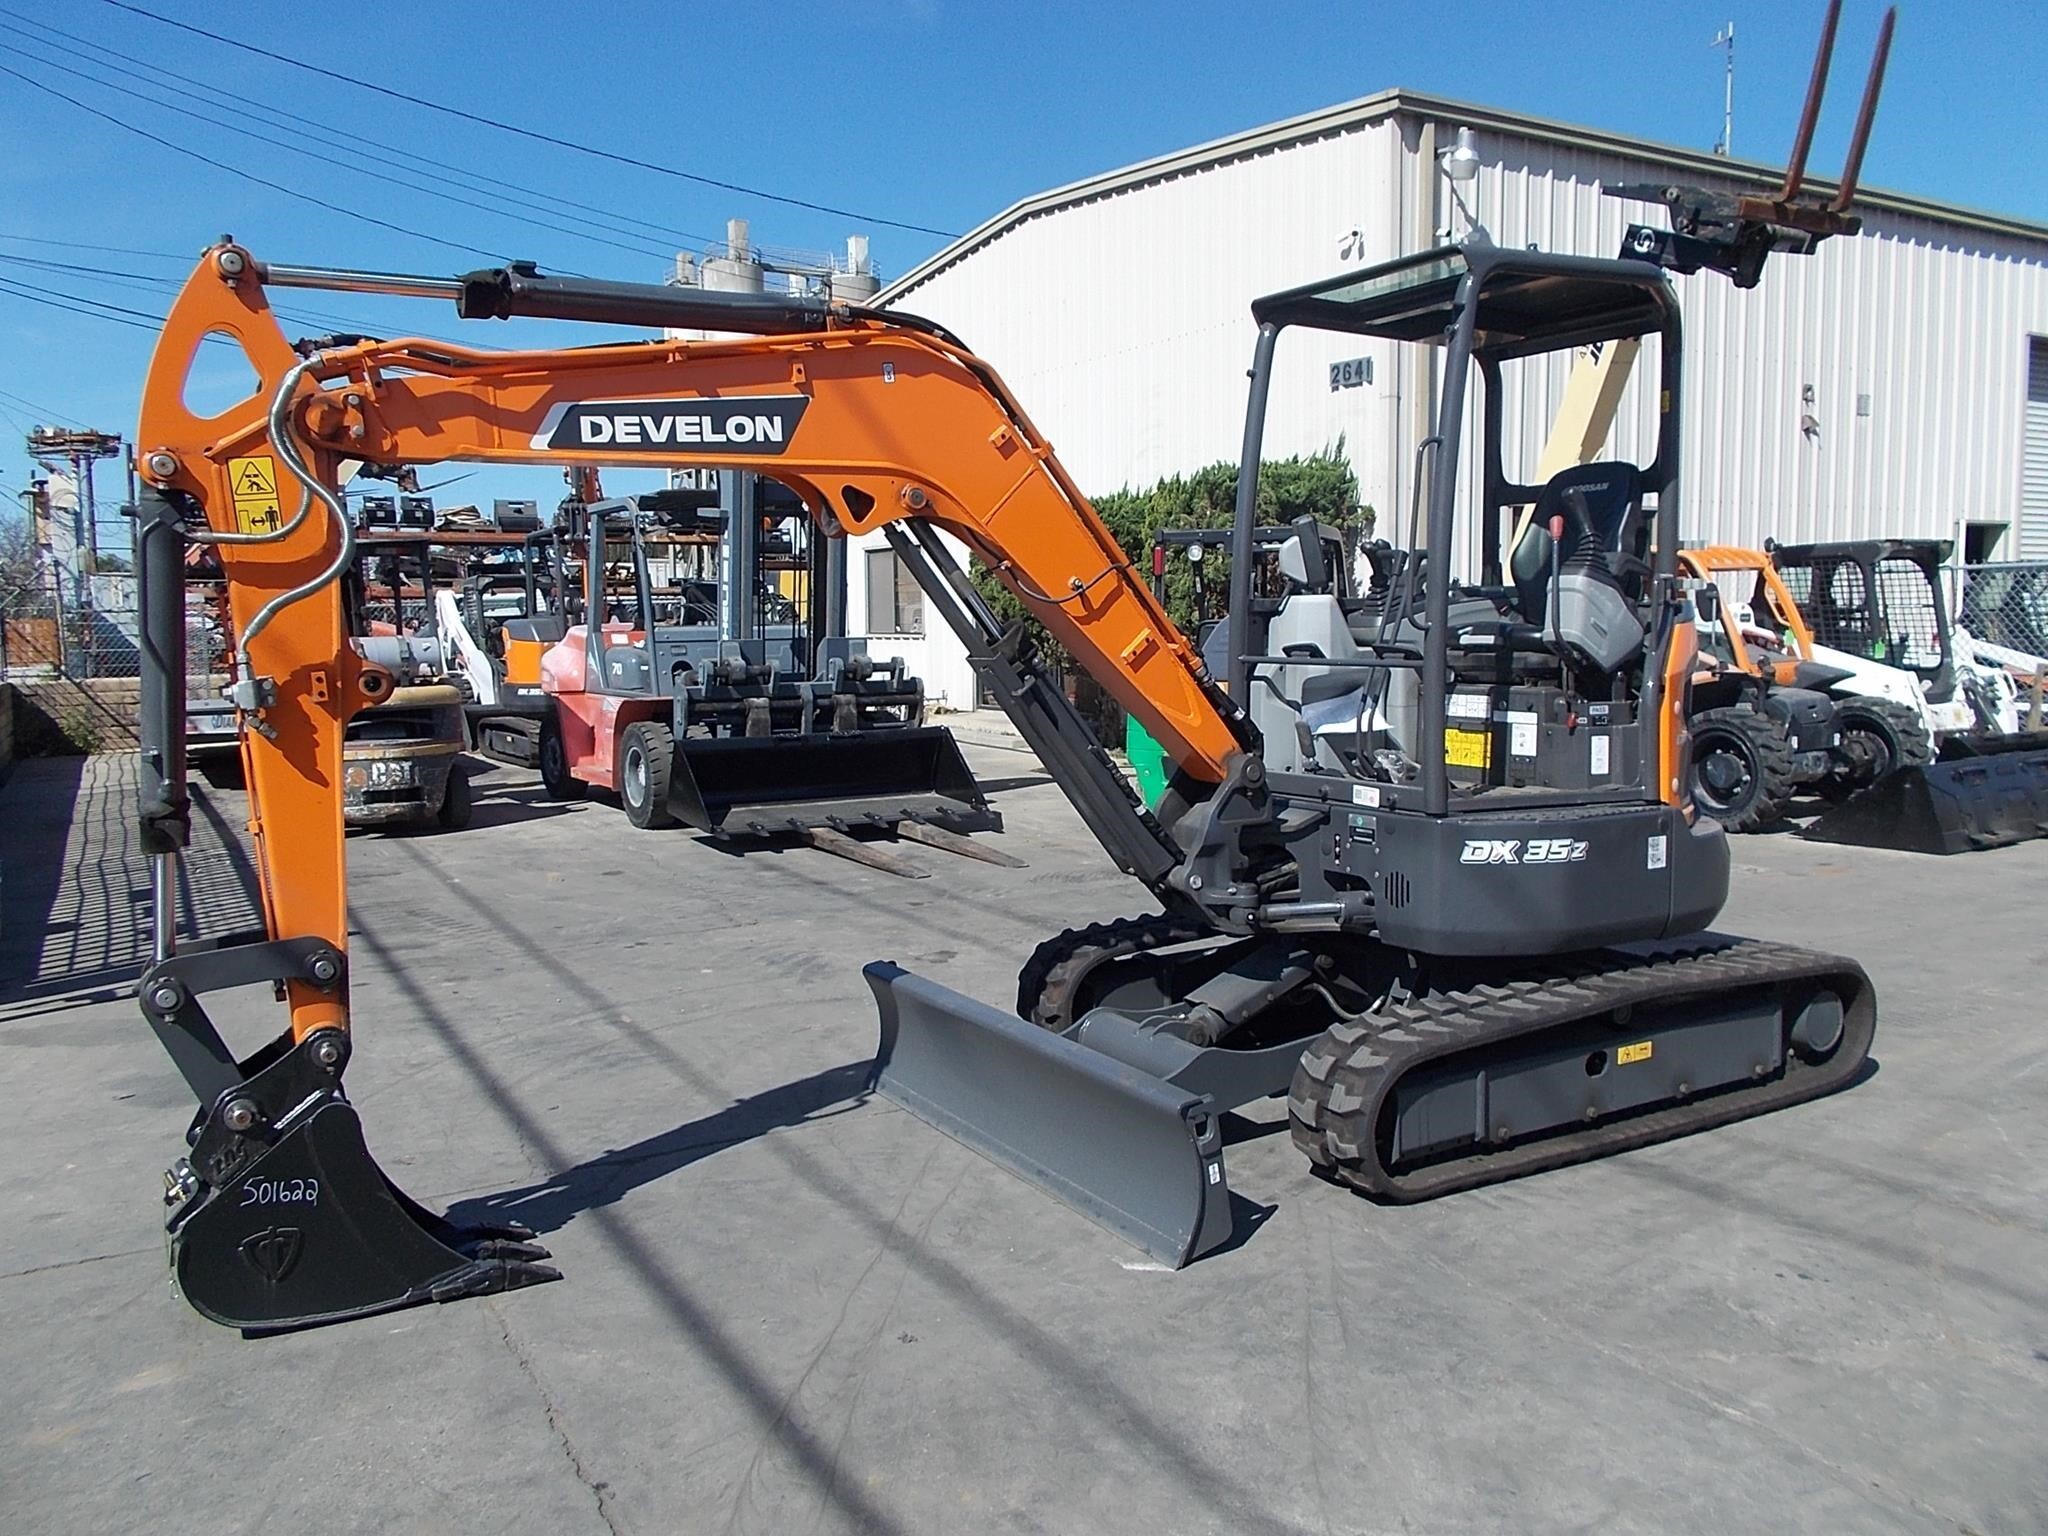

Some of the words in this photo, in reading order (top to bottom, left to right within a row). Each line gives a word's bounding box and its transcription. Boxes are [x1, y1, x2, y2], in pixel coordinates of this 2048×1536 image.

[1331, 357, 1371, 385] 2641
[580, 415, 783, 443] DEVELON
[612, 662, 623, 675] 70
[1460, 840, 1521, 864] DX
[240, 1175, 319, 1207] 501622
